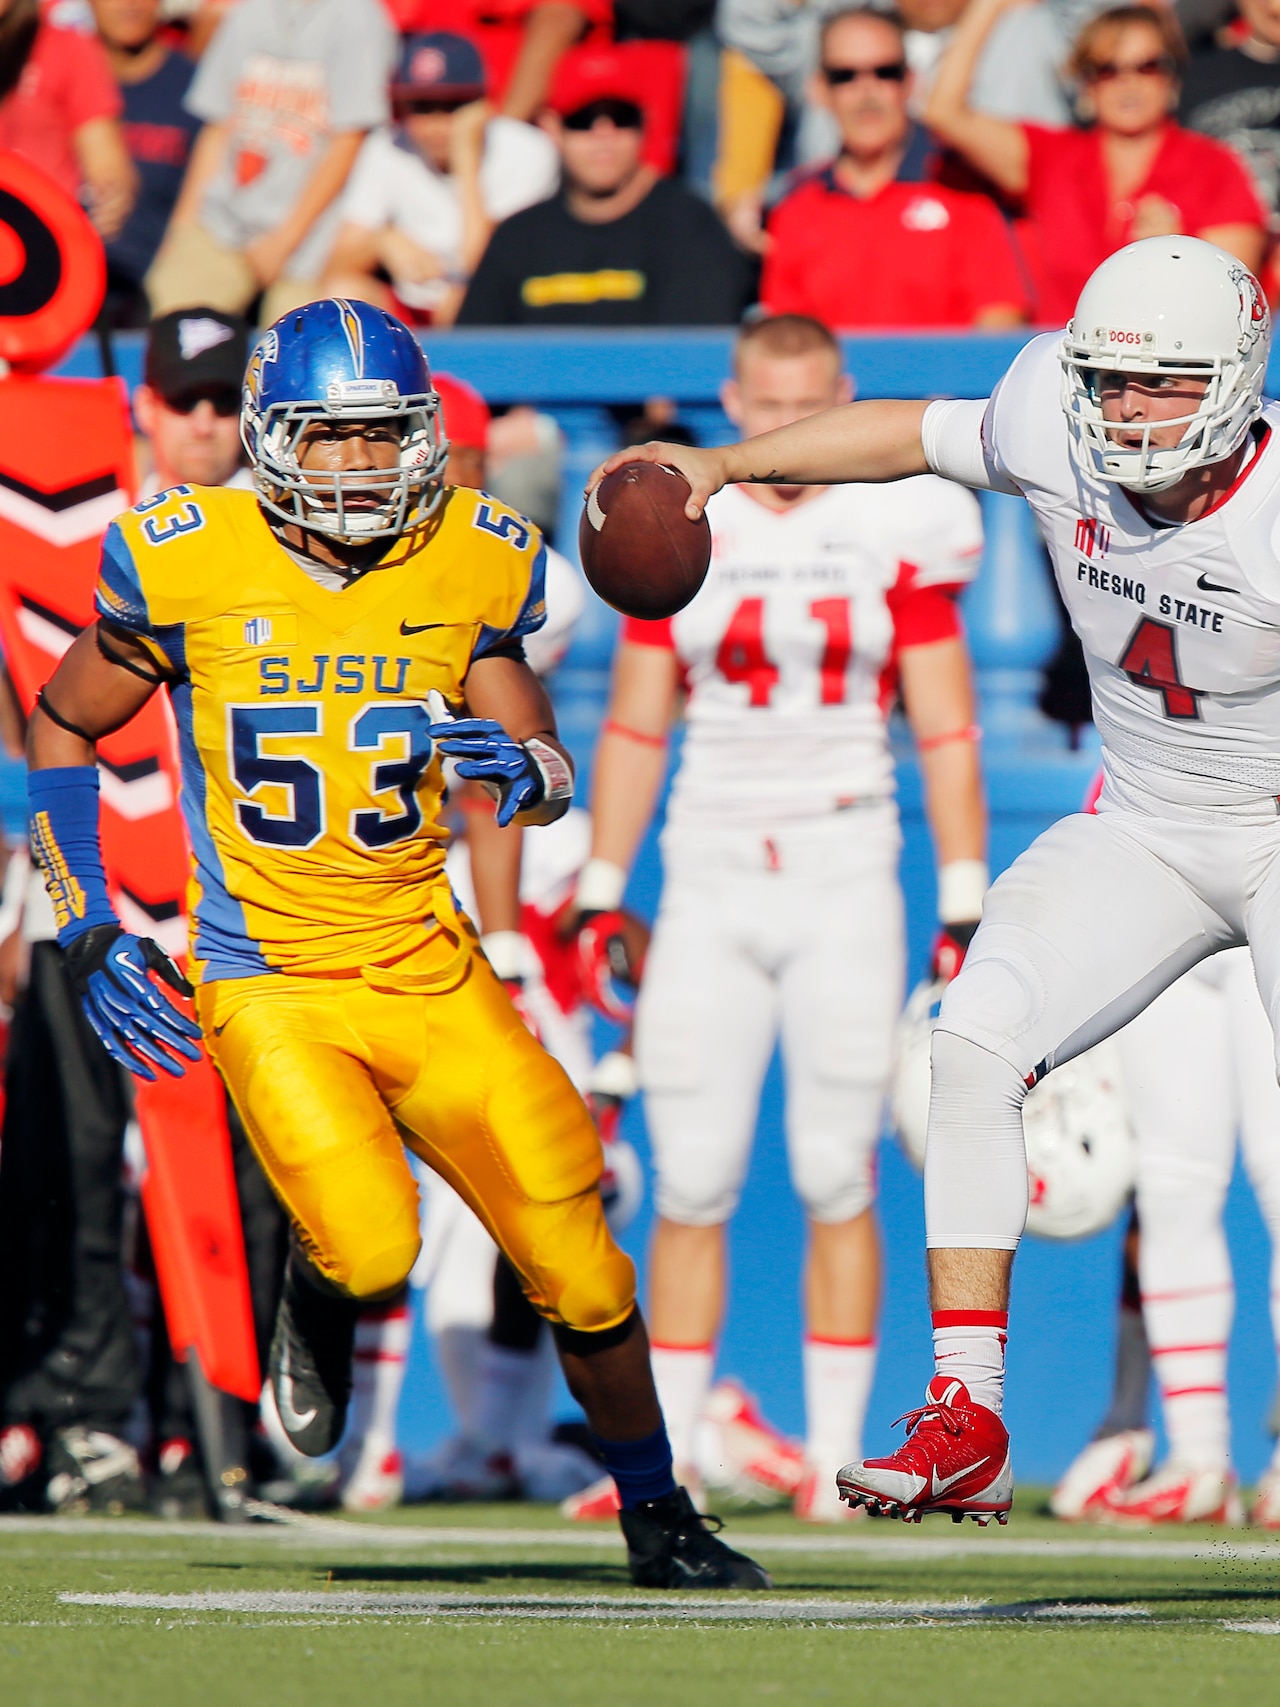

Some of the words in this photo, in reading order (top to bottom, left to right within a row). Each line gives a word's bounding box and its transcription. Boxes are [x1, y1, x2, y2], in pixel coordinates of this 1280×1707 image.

[1108, 330, 1141, 345] DOGS
[345, 384, 377, 392] SPARTANS
[1077, 561, 1146, 605] FRESNO
[1159, 594, 1225, 633] STATE
[259, 655, 412, 695] SJSU
[714, 594, 853, 709] 41
[1115, 611, 1211, 724] 4
[224, 700, 437, 852] 53
